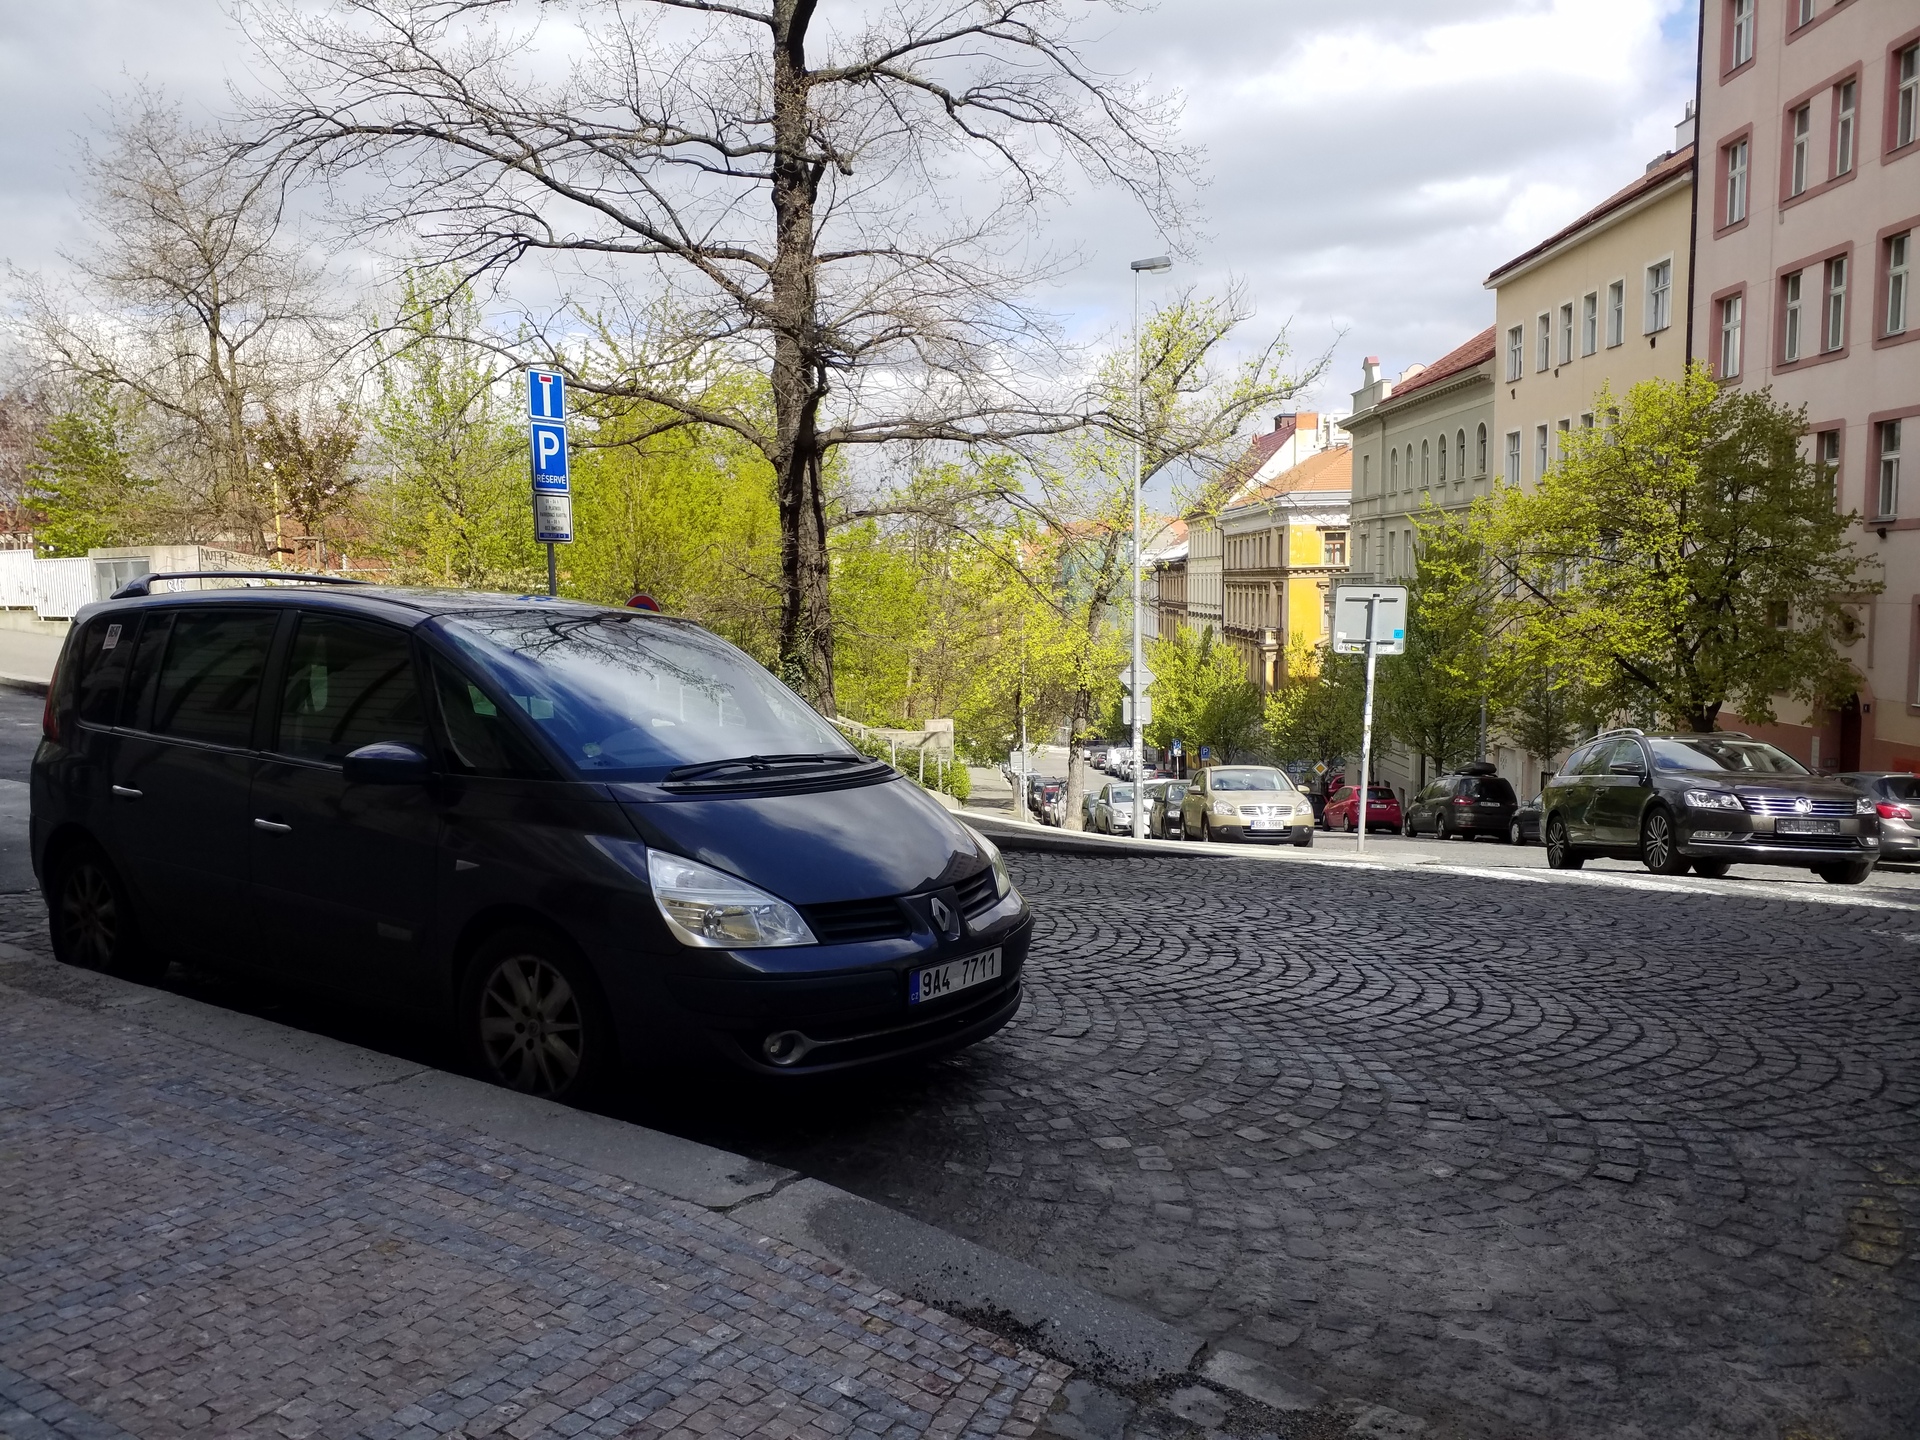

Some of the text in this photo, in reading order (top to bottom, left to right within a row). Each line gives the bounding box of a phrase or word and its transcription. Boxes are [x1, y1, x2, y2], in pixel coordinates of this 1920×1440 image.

[538, 430, 560, 470] P
[537, 473, 566, 484] RÉSERVÉ
[923, 952, 995, 997] 9A4 7711
